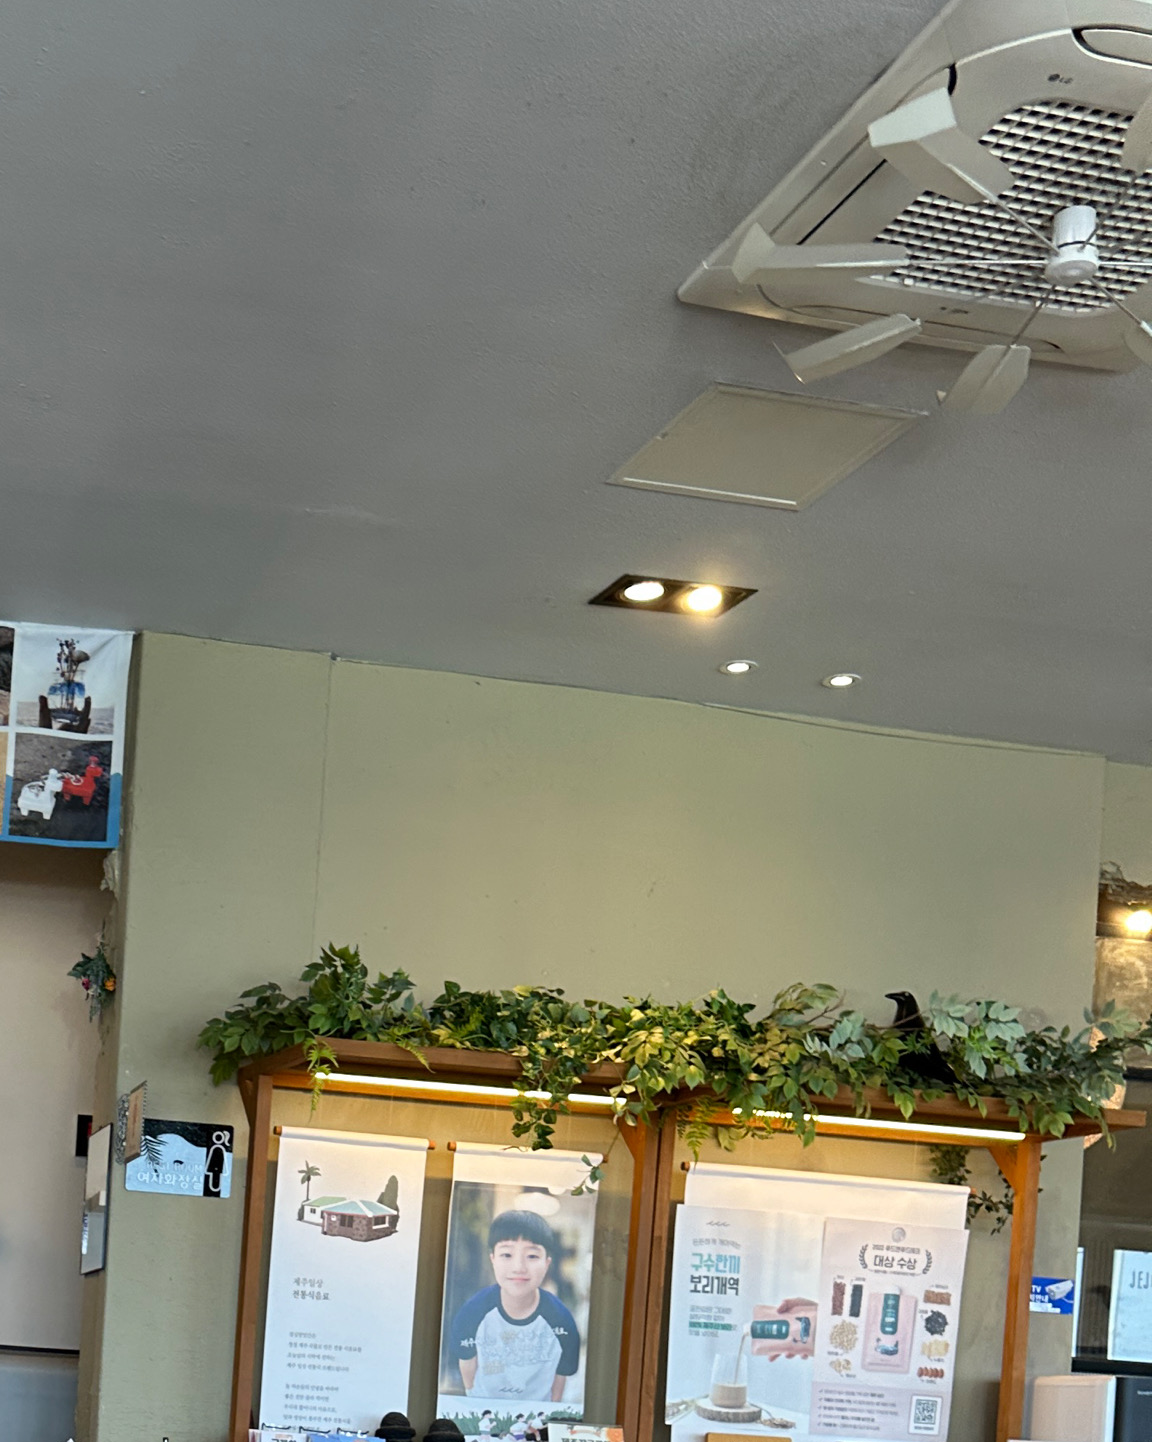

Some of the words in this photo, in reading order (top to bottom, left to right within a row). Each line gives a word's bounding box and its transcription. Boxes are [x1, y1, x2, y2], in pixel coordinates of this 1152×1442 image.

[137, 1171, 203, 1191] 여자화장실
[690, 1252, 741, 1275] 구수한끼
[873, 1254, 895, 1269] 대상
[896, 1256, 918, 1271] 수상
[689, 1274, 740, 1296] 보리개역
[1129, 1271, 1152, 1289] JEJ
